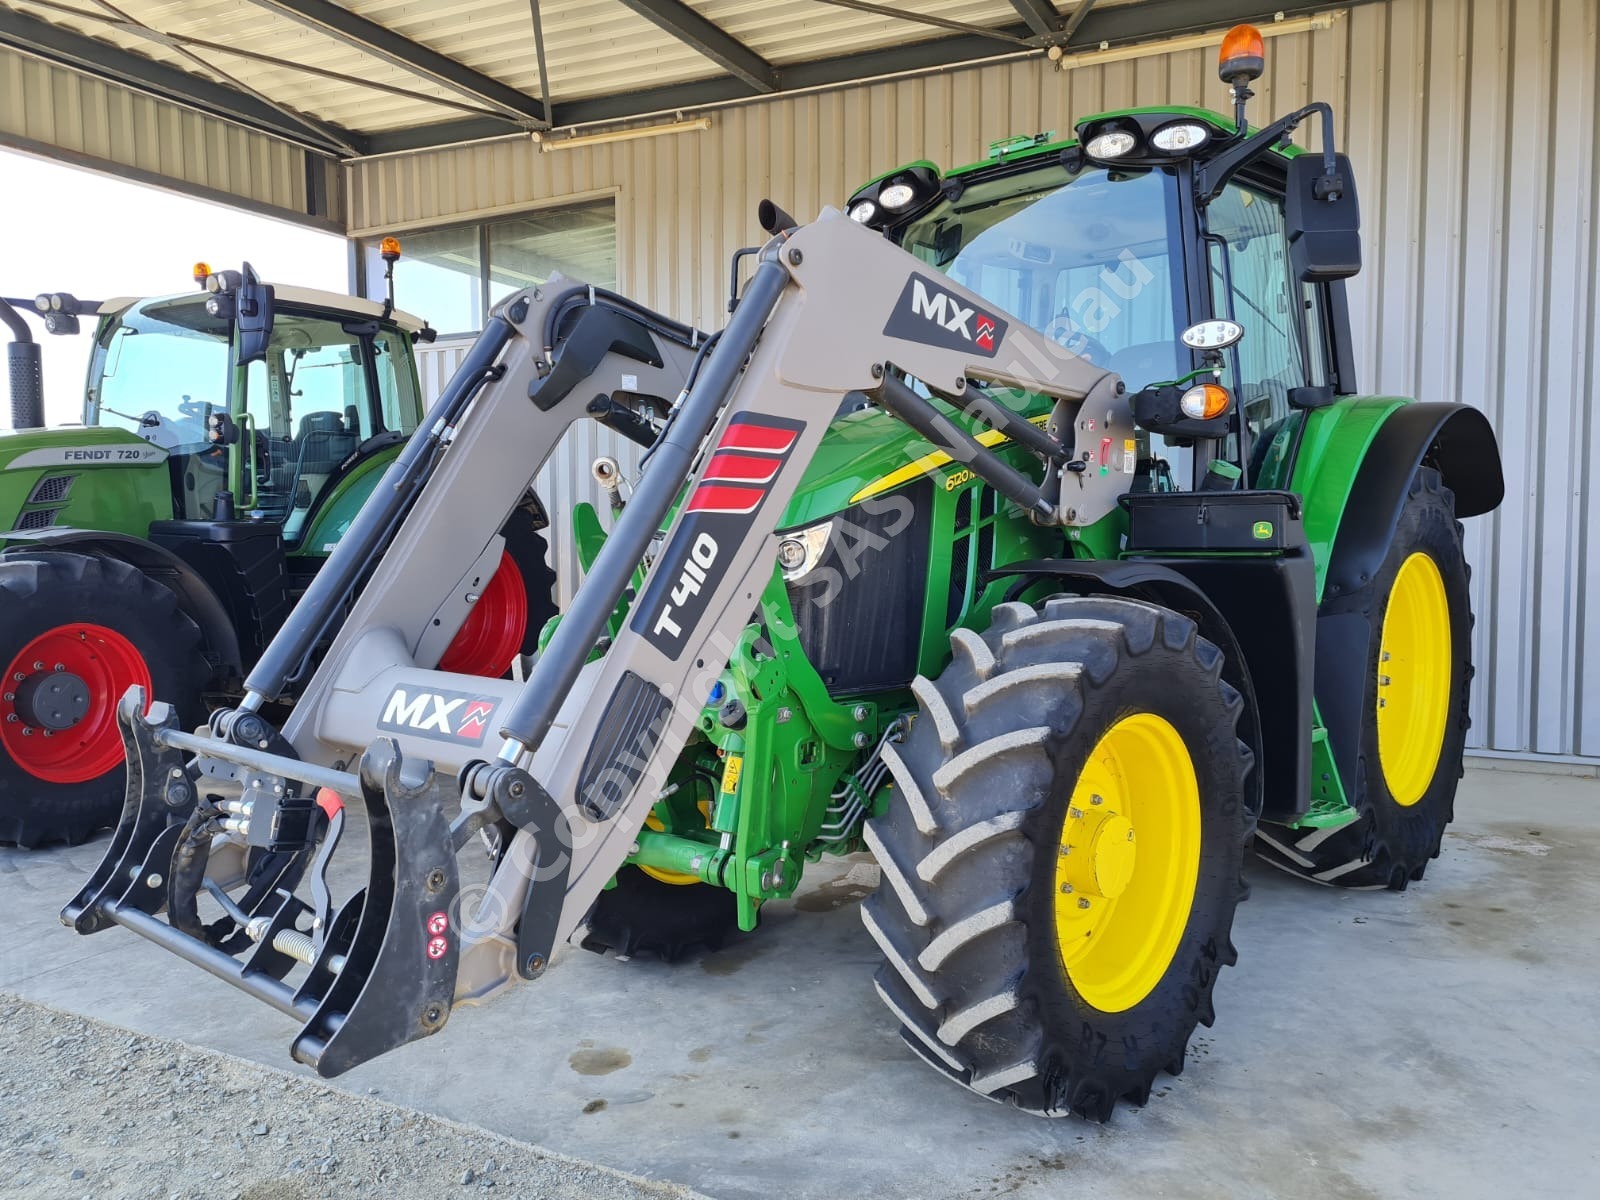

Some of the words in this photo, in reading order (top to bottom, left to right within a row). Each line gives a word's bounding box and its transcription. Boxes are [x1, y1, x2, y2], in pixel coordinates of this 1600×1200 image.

[911, 279, 975, 341] MX
[64, 450, 112, 460] FENDT
[117, 450, 140, 460] 720
[382, 689, 467, 734] MX
